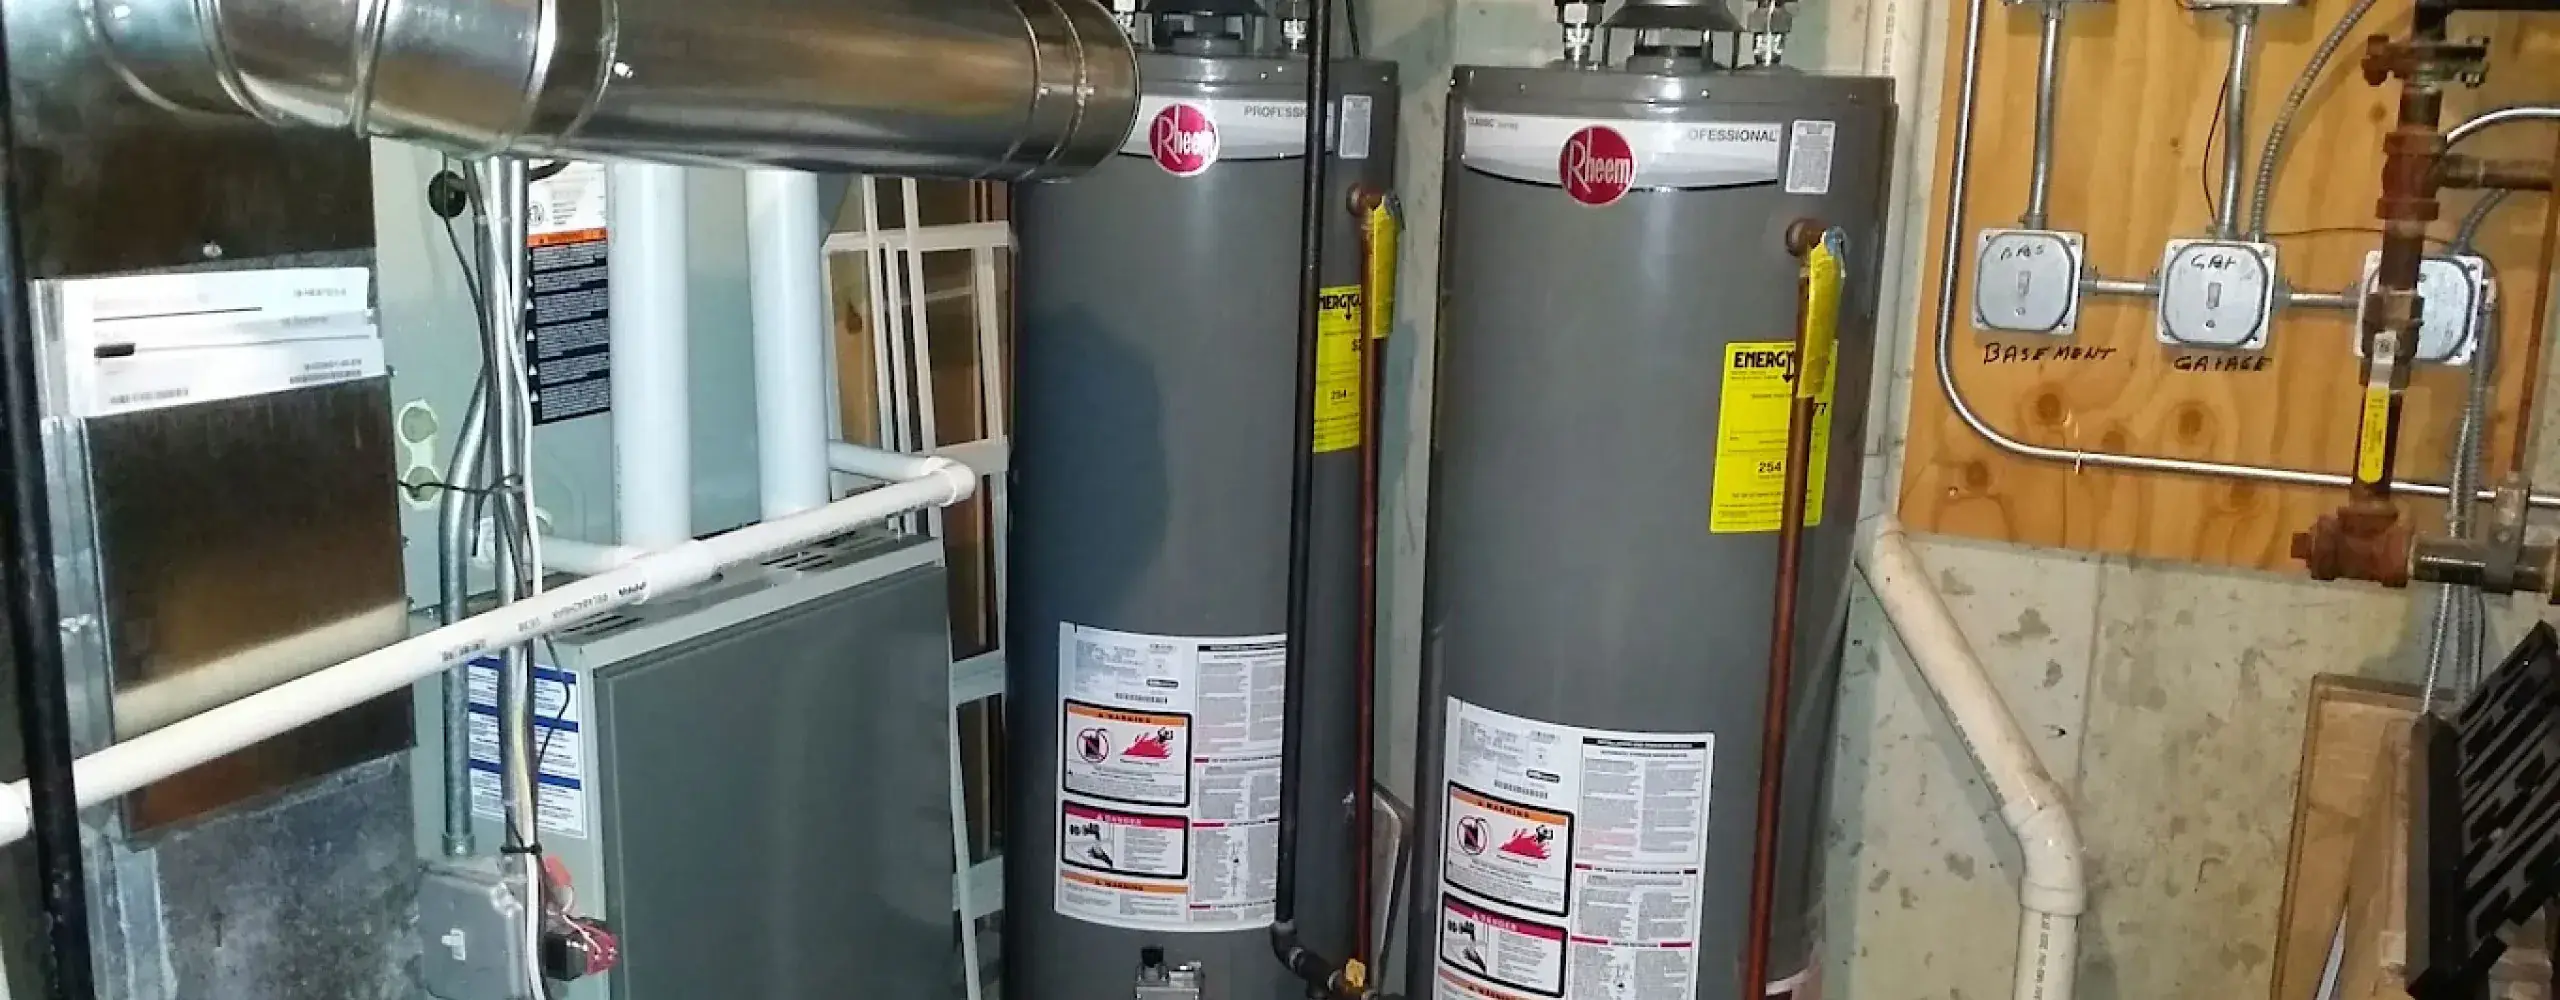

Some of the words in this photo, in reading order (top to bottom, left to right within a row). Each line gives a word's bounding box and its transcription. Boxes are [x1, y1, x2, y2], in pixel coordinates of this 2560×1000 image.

[1244, 105, 1306, 118] PROFESSI
[1157, 104, 1214, 164] Rheem
[1688, 128, 1777, 142] OFESSIONAL
[1567, 127, 1631, 193] Rheem
[1983, 342, 2117, 366] BASEMENT
[1757, 460, 1782, 474] 254
